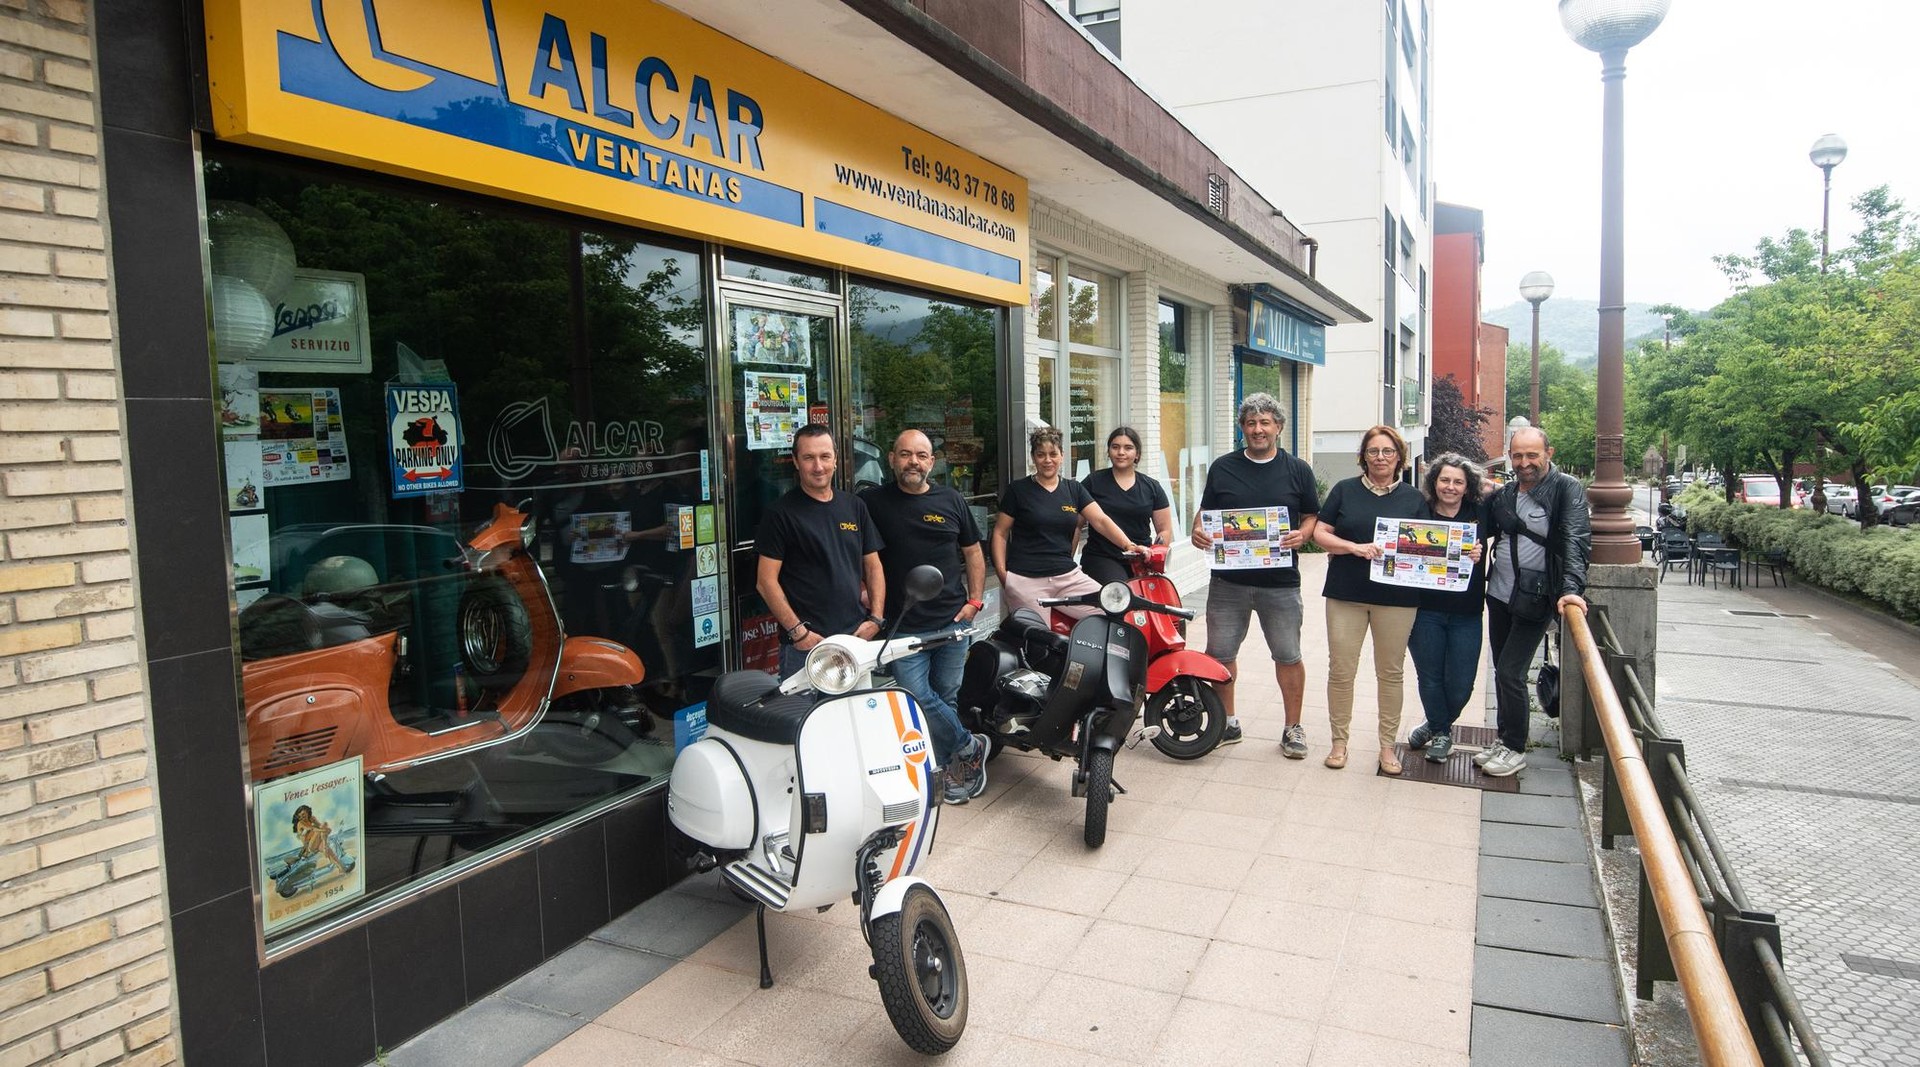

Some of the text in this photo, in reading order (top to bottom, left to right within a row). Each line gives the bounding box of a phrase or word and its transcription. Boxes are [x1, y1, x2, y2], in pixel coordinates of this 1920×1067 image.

[528, 12, 765, 171] ALCAR
[566, 128, 743, 204] VENTANAS
[901, 146, 1016, 213] Tel: 943 37 78 68
[834, 163, 1017, 243] www.ventanasalcar.com
[291, 338, 350, 352] SERVIZIO
[392, 389, 453, 414] VESPA
[565, 420, 665, 457] ALCAR
[395, 445, 456, 468] PARKING ONLY
[580, 462, 654, 478] VENTANAS
[397, 480, 459, 491] NO OTHER BIKES ALLOWED
[902, 740, 927, 754] Gulf
[283, 776, 356, 803] Venez l'essayer...
[324, 884, 344, 898] 1954
